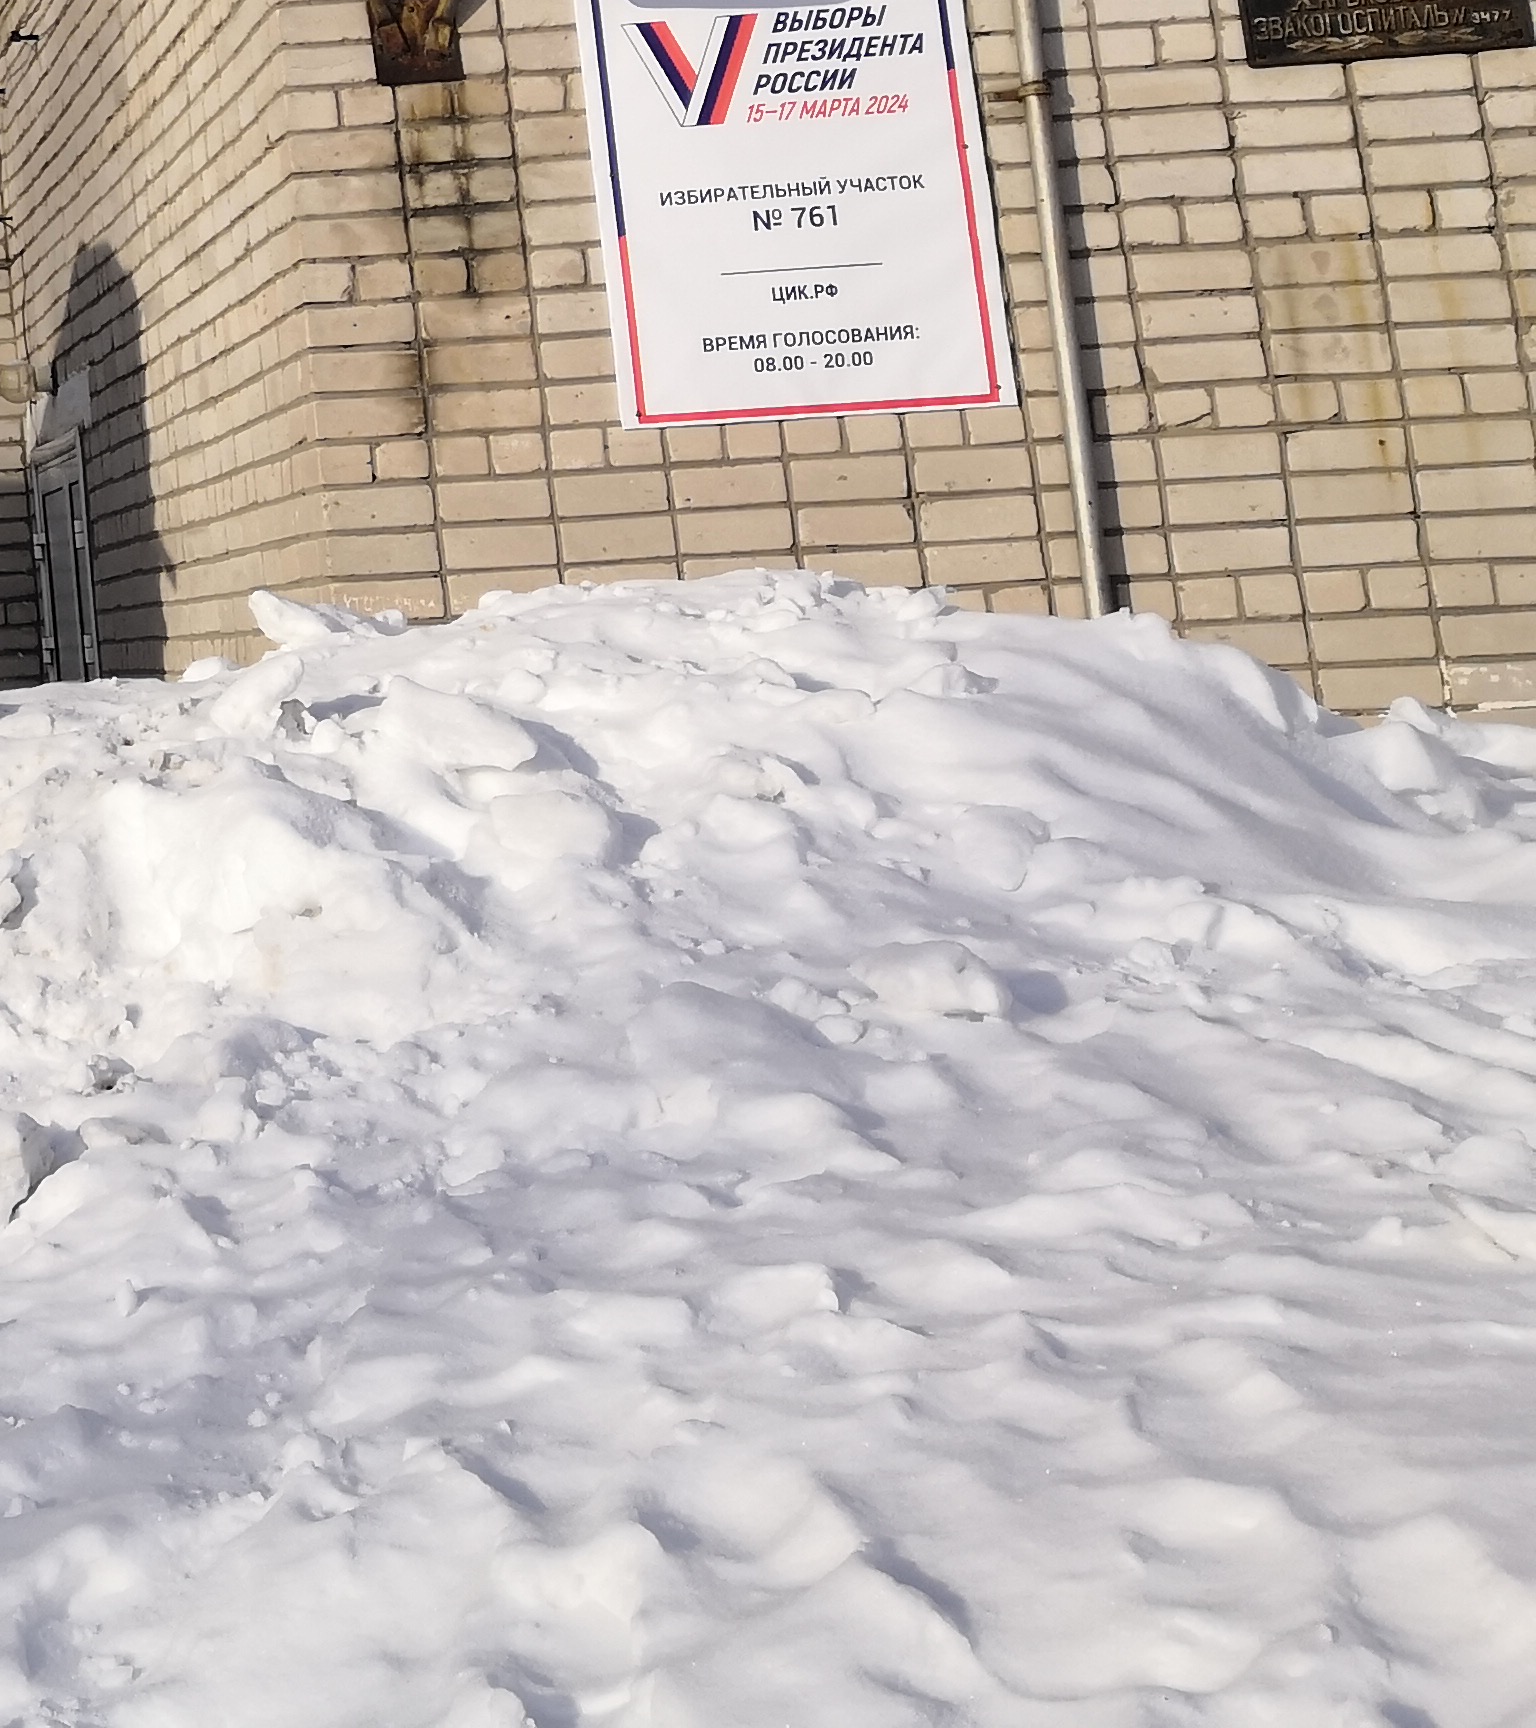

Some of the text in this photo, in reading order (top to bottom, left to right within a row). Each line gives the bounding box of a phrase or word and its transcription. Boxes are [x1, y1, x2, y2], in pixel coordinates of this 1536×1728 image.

[771, 5, 888, 34] ВЫБОРЫ
[762, 33, 924, 65] ПРЕЗИДЕНТА
[753, 68, 857, 96] РОССИИ
[799, 96, 862, 121] МАРТА
[866, 94, 910, 118] 2024
[659, 173, 925, 207] ИЗБИРАТЕЛЬНЫЙ УЧАСТОК
[752, 205, 840, 232] № 761
[771, 283, 839, 305] ЦИК.РФ
[702, 325, 921, 353] ВРЕМЯ ГОЛОСОВАНИЯ:
[754, 355, 805, 373] 08.00
[824, 351, 874, 369] 20.00
